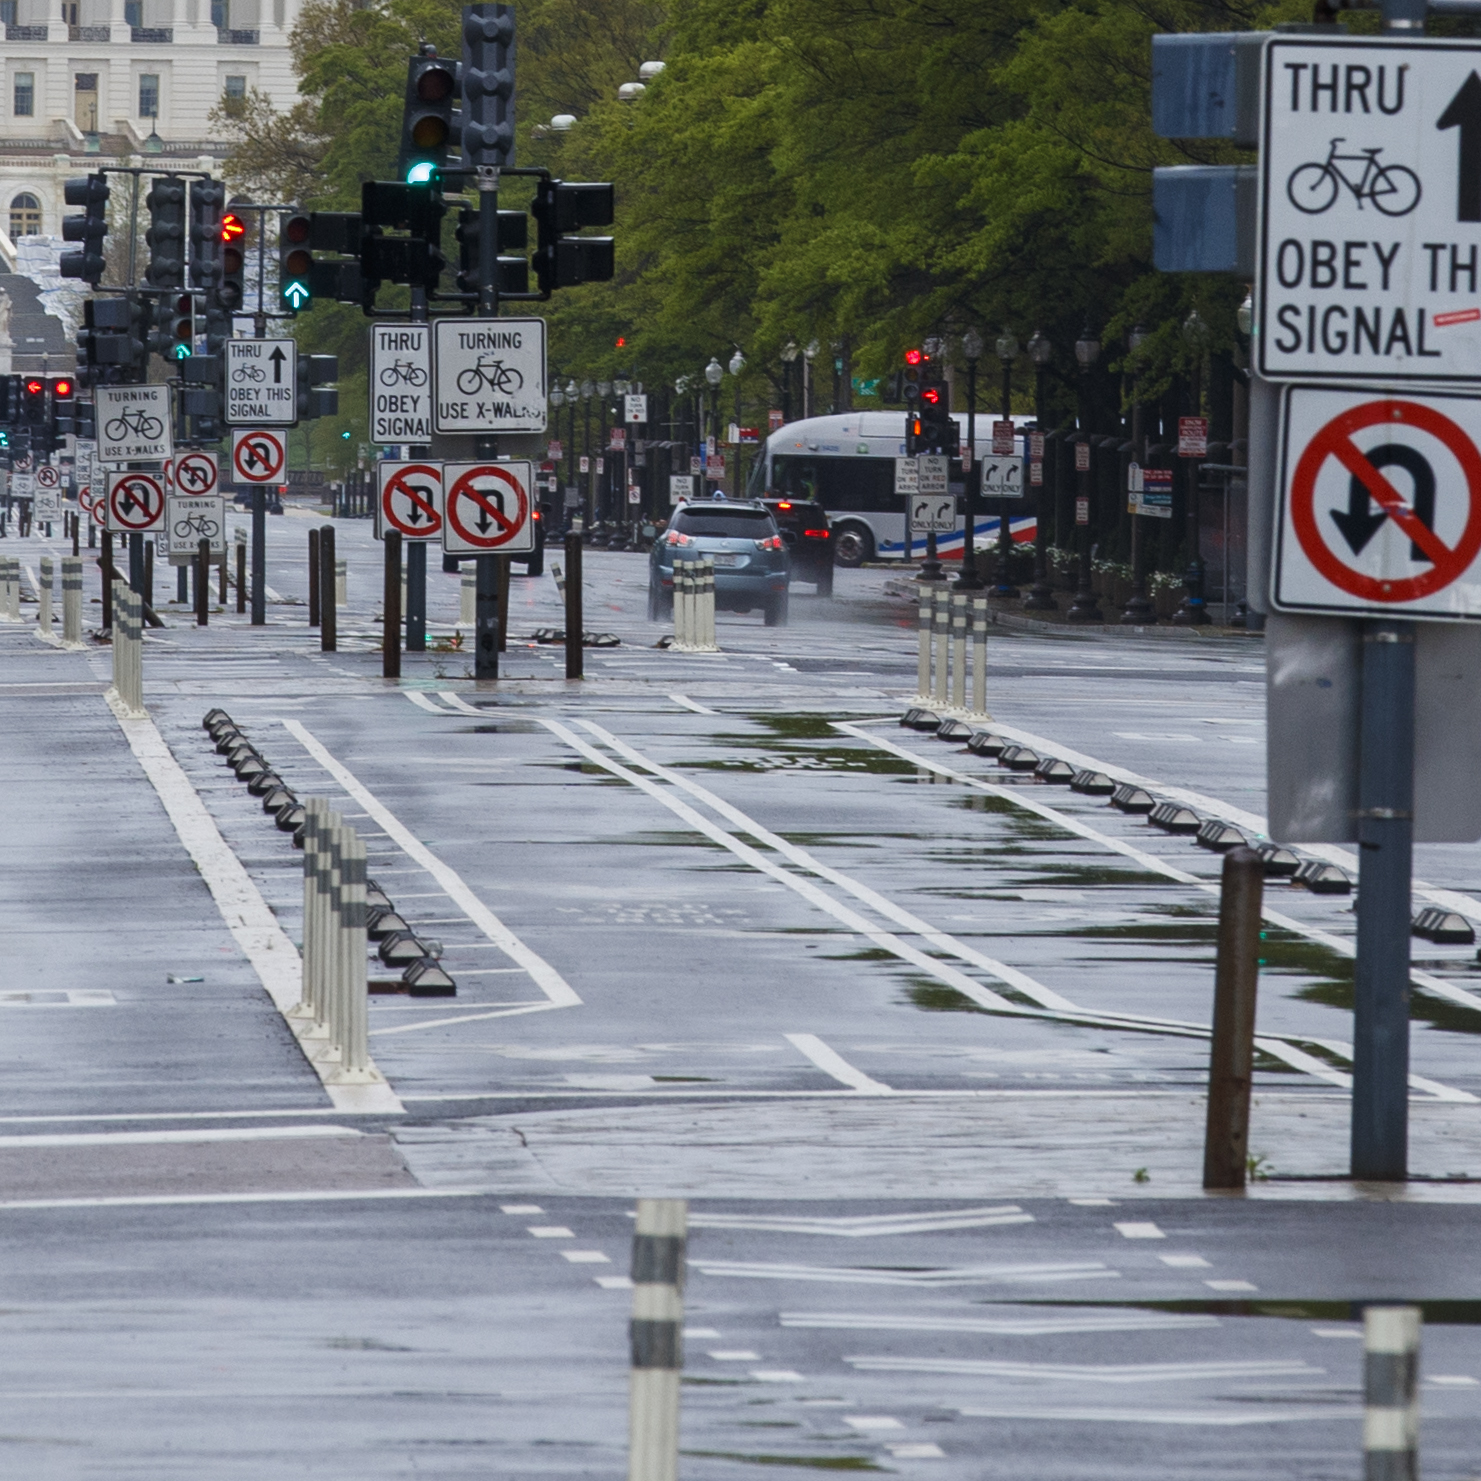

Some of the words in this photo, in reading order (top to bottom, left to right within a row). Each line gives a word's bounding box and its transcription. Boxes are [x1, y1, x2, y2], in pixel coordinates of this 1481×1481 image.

[1283, 62, 1407, 116] THRU
[1276, 238, 1401, 291] OBEY
[1275, 303, 1442, 357] SIGNAL
[379, 332, 422, 351] THRU
[458, 332, 522, 350] TURNING
[230, 344, 262, 358] THRU
[108, 391, 158, 402] TURNING
[230, 388, 261, 400] OBEY
[266, 388, 292, 400] THIS
[230, 404, 272, 417] SIGNAL
[376, 395, 420, 413] OBEY
[440, 402, 470, 420] USE
[105, 446, 122, 456] USE
[125, 444, 166, 455] X-WALKS
[1002, 484, 1020, 492] ONLY
[912, 520, 932, 529] ONLY
[934, 520, 954, 529] ONLY
